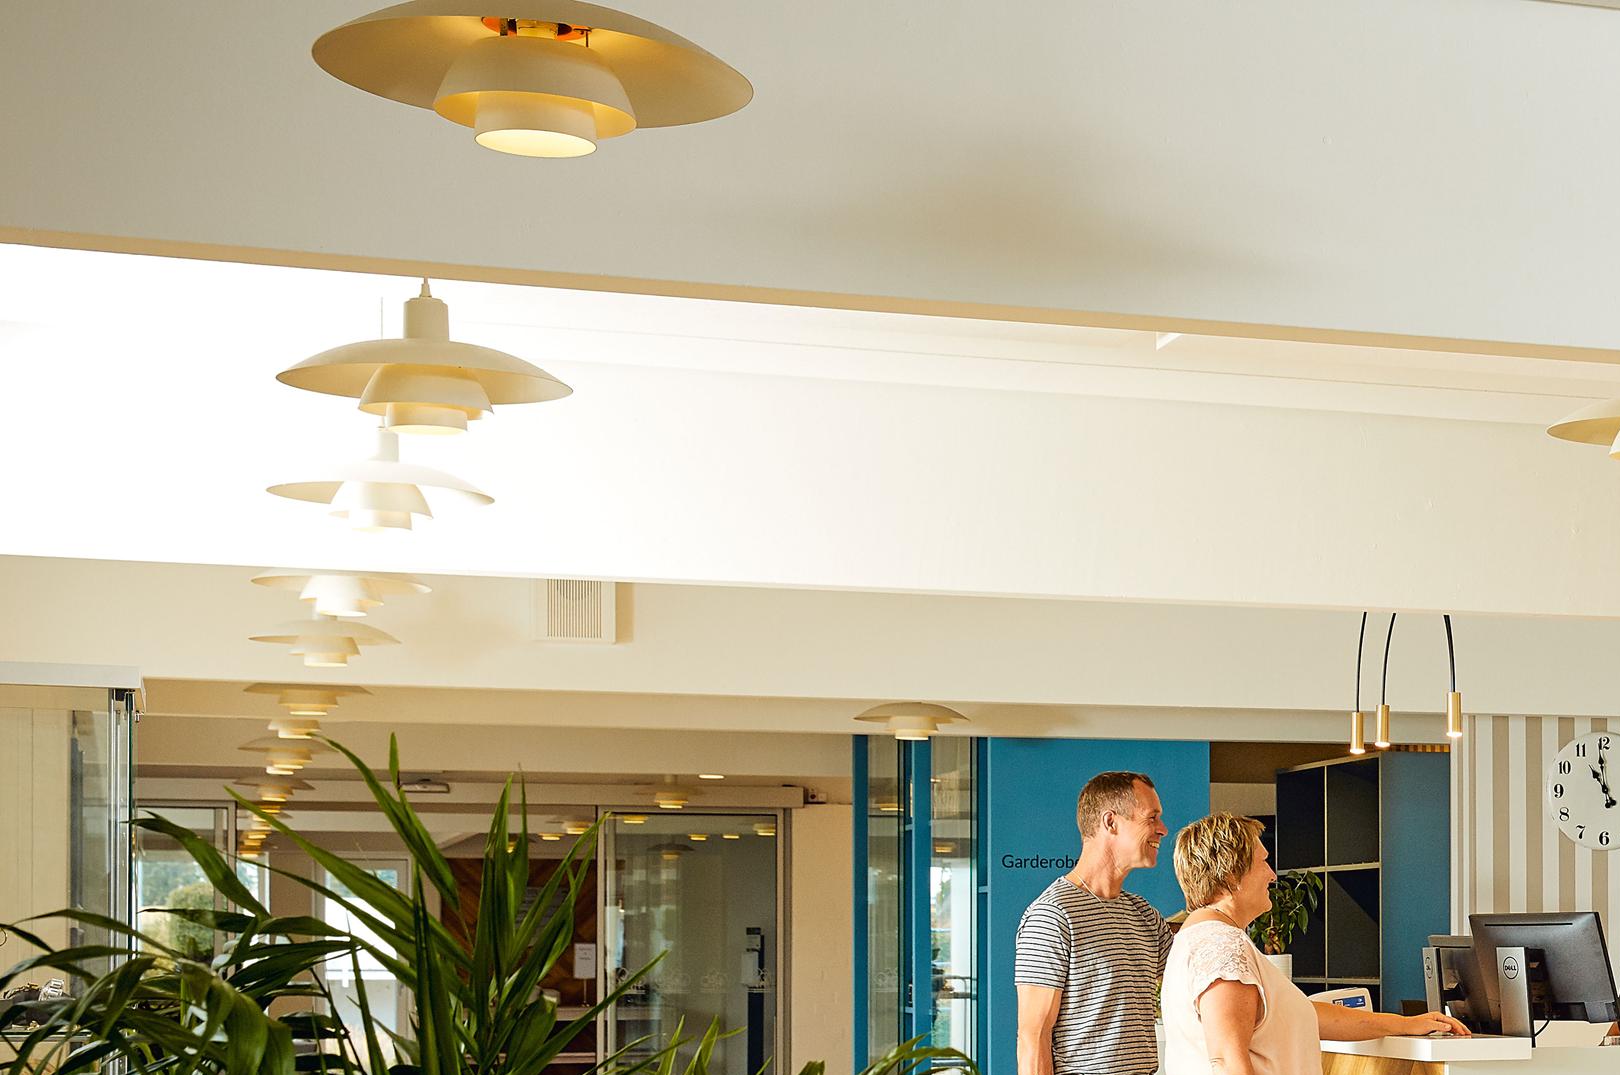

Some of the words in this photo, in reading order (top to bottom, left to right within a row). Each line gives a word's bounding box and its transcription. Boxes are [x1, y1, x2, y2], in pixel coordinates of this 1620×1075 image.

[1576, 743, 1585, 757] 11
[1559, 760, 1571, 774] 10
[1554, 784, 1564, 798] 9
[1559, 807, 1569, 821] 8
[1576, 825, 1585, 839] 7
[1599, 831, 1609, 845] 6
